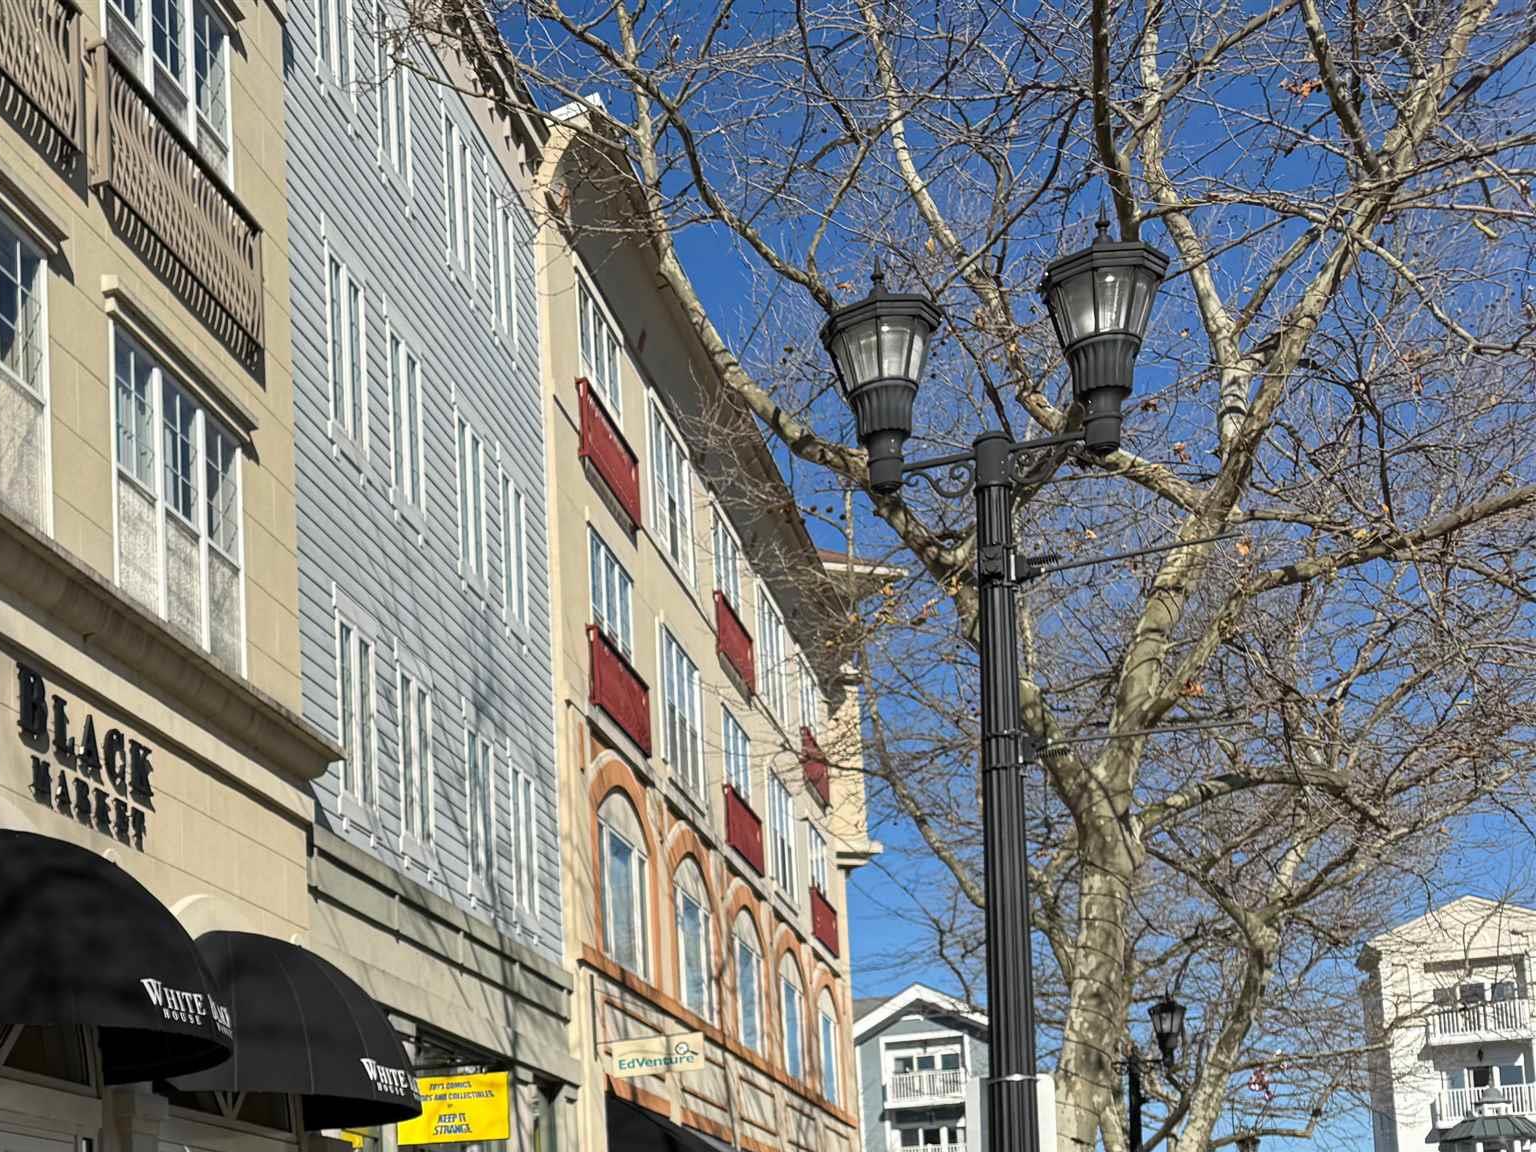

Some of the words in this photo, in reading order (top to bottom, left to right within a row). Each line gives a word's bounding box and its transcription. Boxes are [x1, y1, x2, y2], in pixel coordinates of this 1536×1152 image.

[16, 662, 154, 810] BLACK
[29, 755, 146, 850] MARKET
[140, 978, 206, 1016] WHITE
[163, 1007, 202, 1026] HOUSE
[360, 1057, 408, 1089] WHITE
[618, 1055, 695, 1070] EdVenture
[437, 1113, 457, 1124] KEEP
